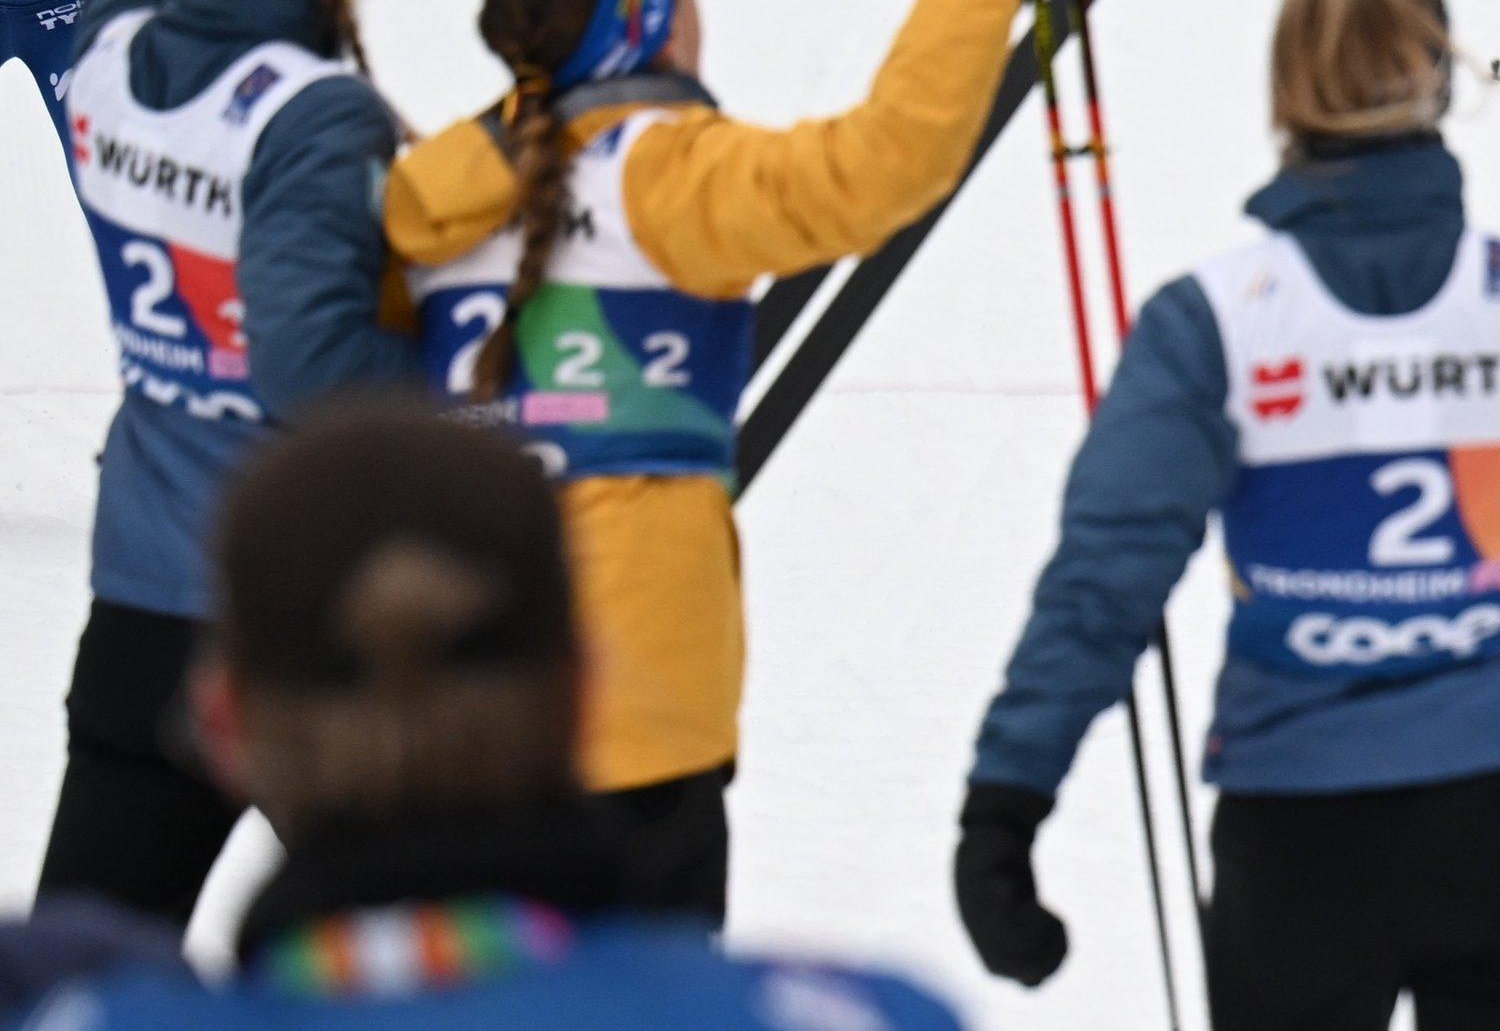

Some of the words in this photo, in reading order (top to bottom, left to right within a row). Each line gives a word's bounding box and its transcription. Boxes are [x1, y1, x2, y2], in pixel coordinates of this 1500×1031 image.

[121, 241, 187, 340] 2
[554, 330, 605, 387] 2
[641, 330, 691, 388] 2
[1367, 456, 1456, 568] 2
